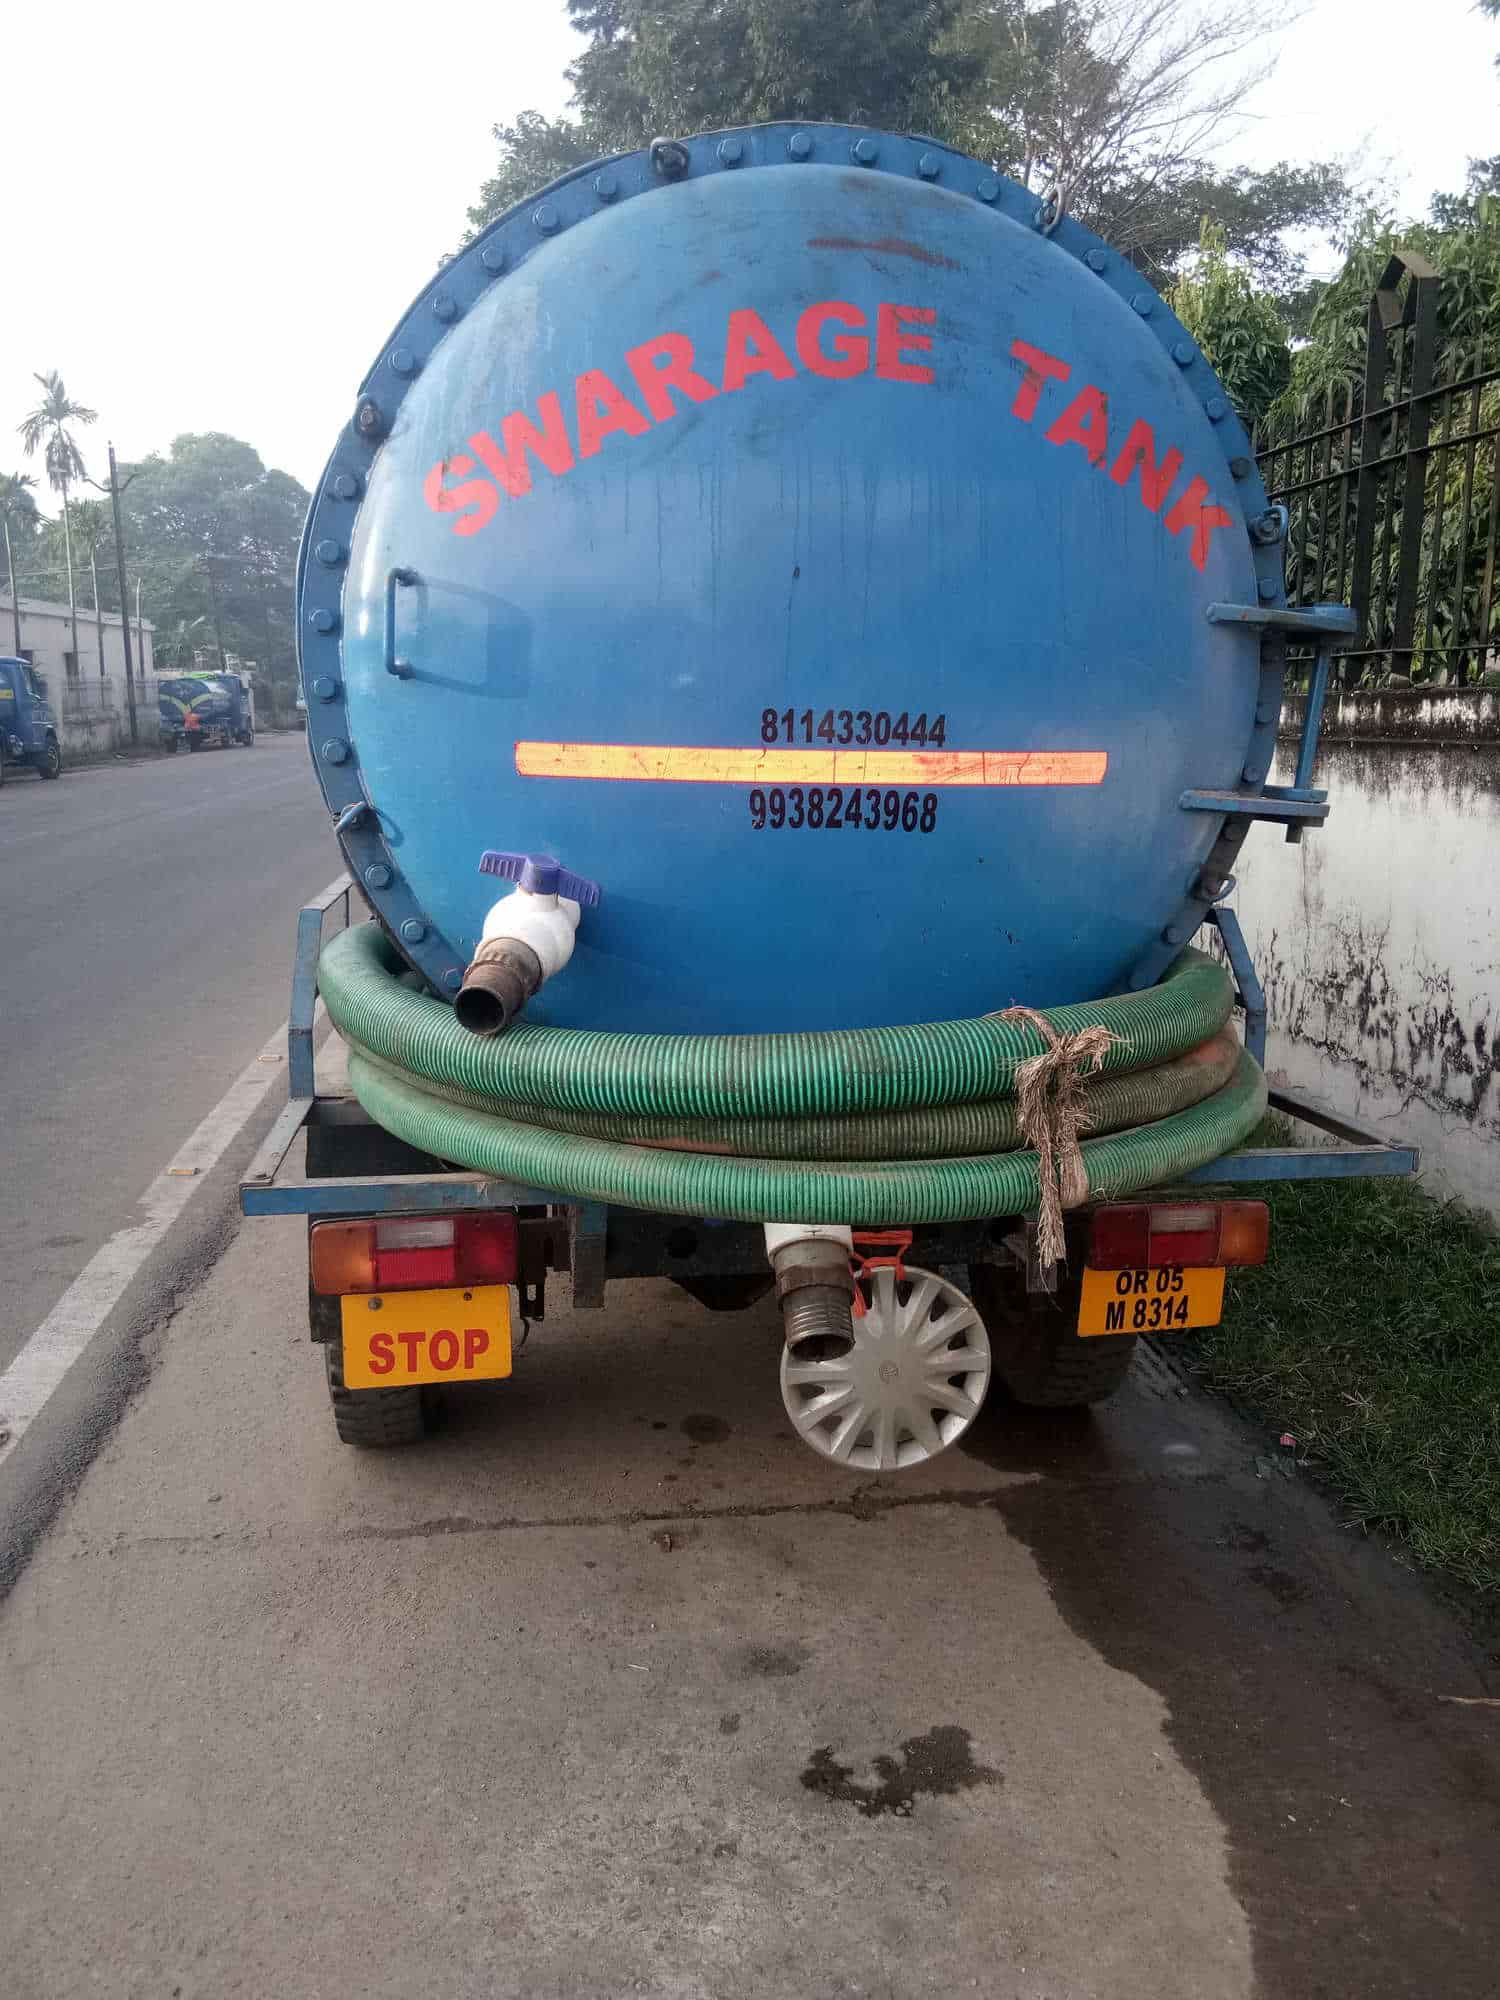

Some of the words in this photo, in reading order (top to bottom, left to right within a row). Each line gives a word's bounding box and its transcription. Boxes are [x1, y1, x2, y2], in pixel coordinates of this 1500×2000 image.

[423, 301, 936, 538] SWARAGE
[1008, 338, 1233, 573] TANK
[761, 708, 946, 747] 8114330444
[749, 787, 938, 833] 9938243968
[1116, 1270, 1149, 1295] OR
[1156, 1264, 1185, 1292] 05
[1105, 1301, 1126, 1330] M
[1132, 1295, 1189, 1328] 8314
[368, 1329, 490, 1375] STOP
